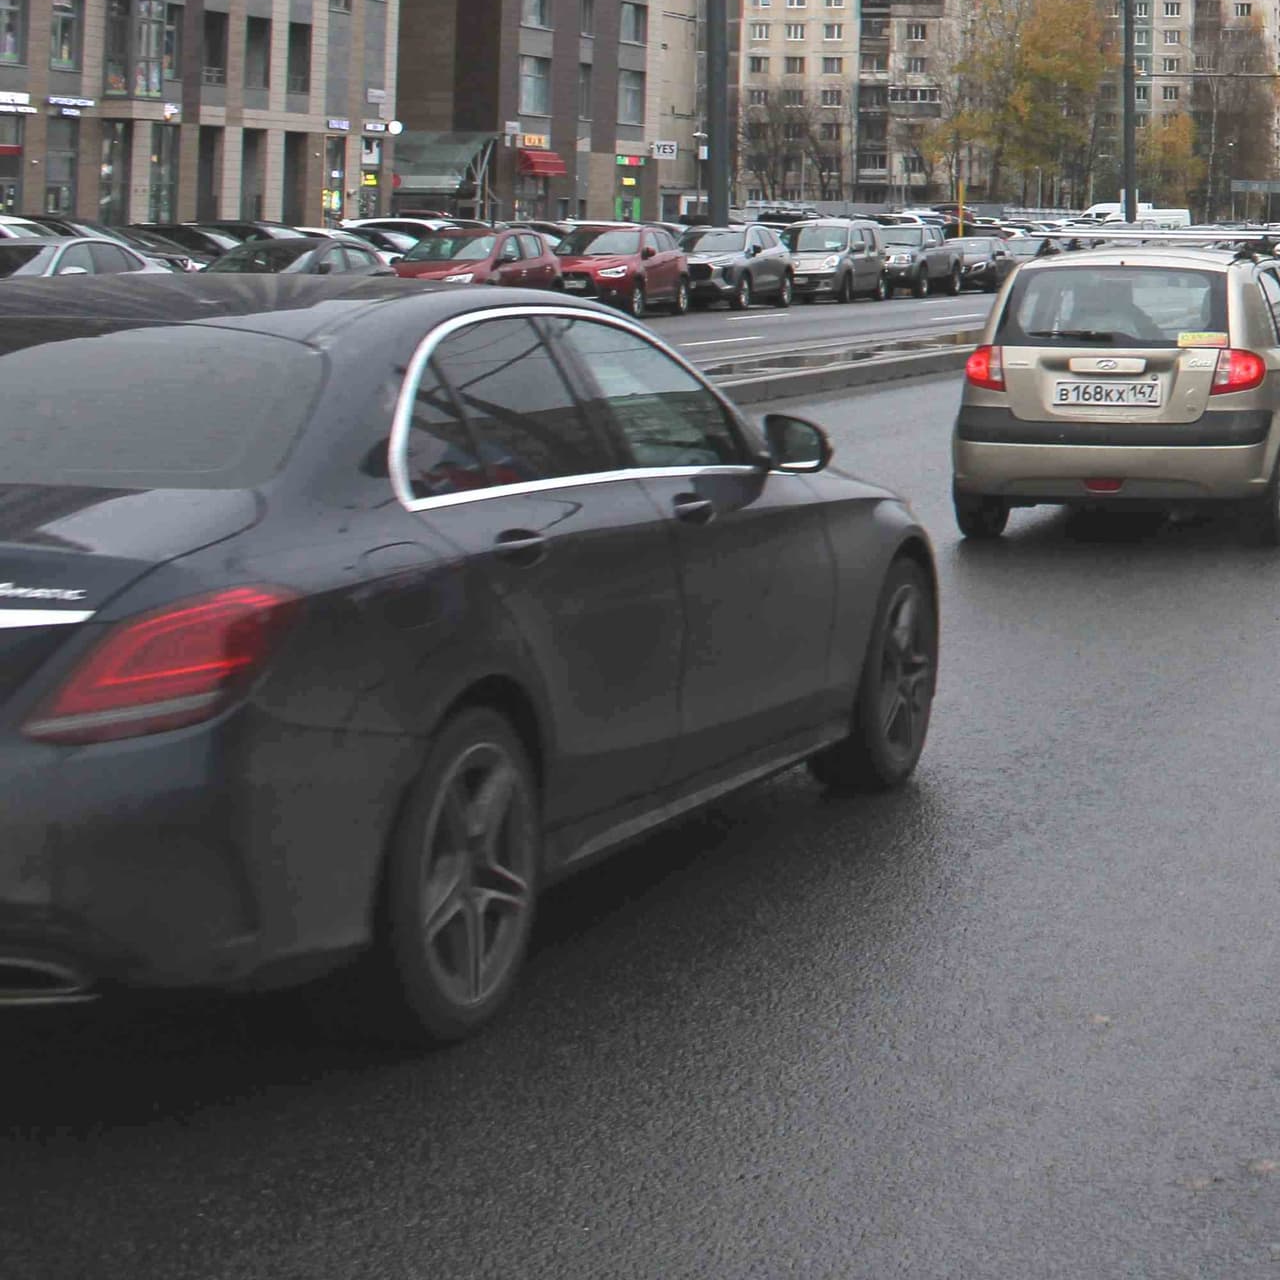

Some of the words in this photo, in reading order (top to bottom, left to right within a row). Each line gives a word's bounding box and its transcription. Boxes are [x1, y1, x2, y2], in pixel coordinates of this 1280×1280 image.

[656, 144, 674, 154] YES
[1059, 385, 1125, 401] В168КХ
[1129, 386, 1155, 399] 147
